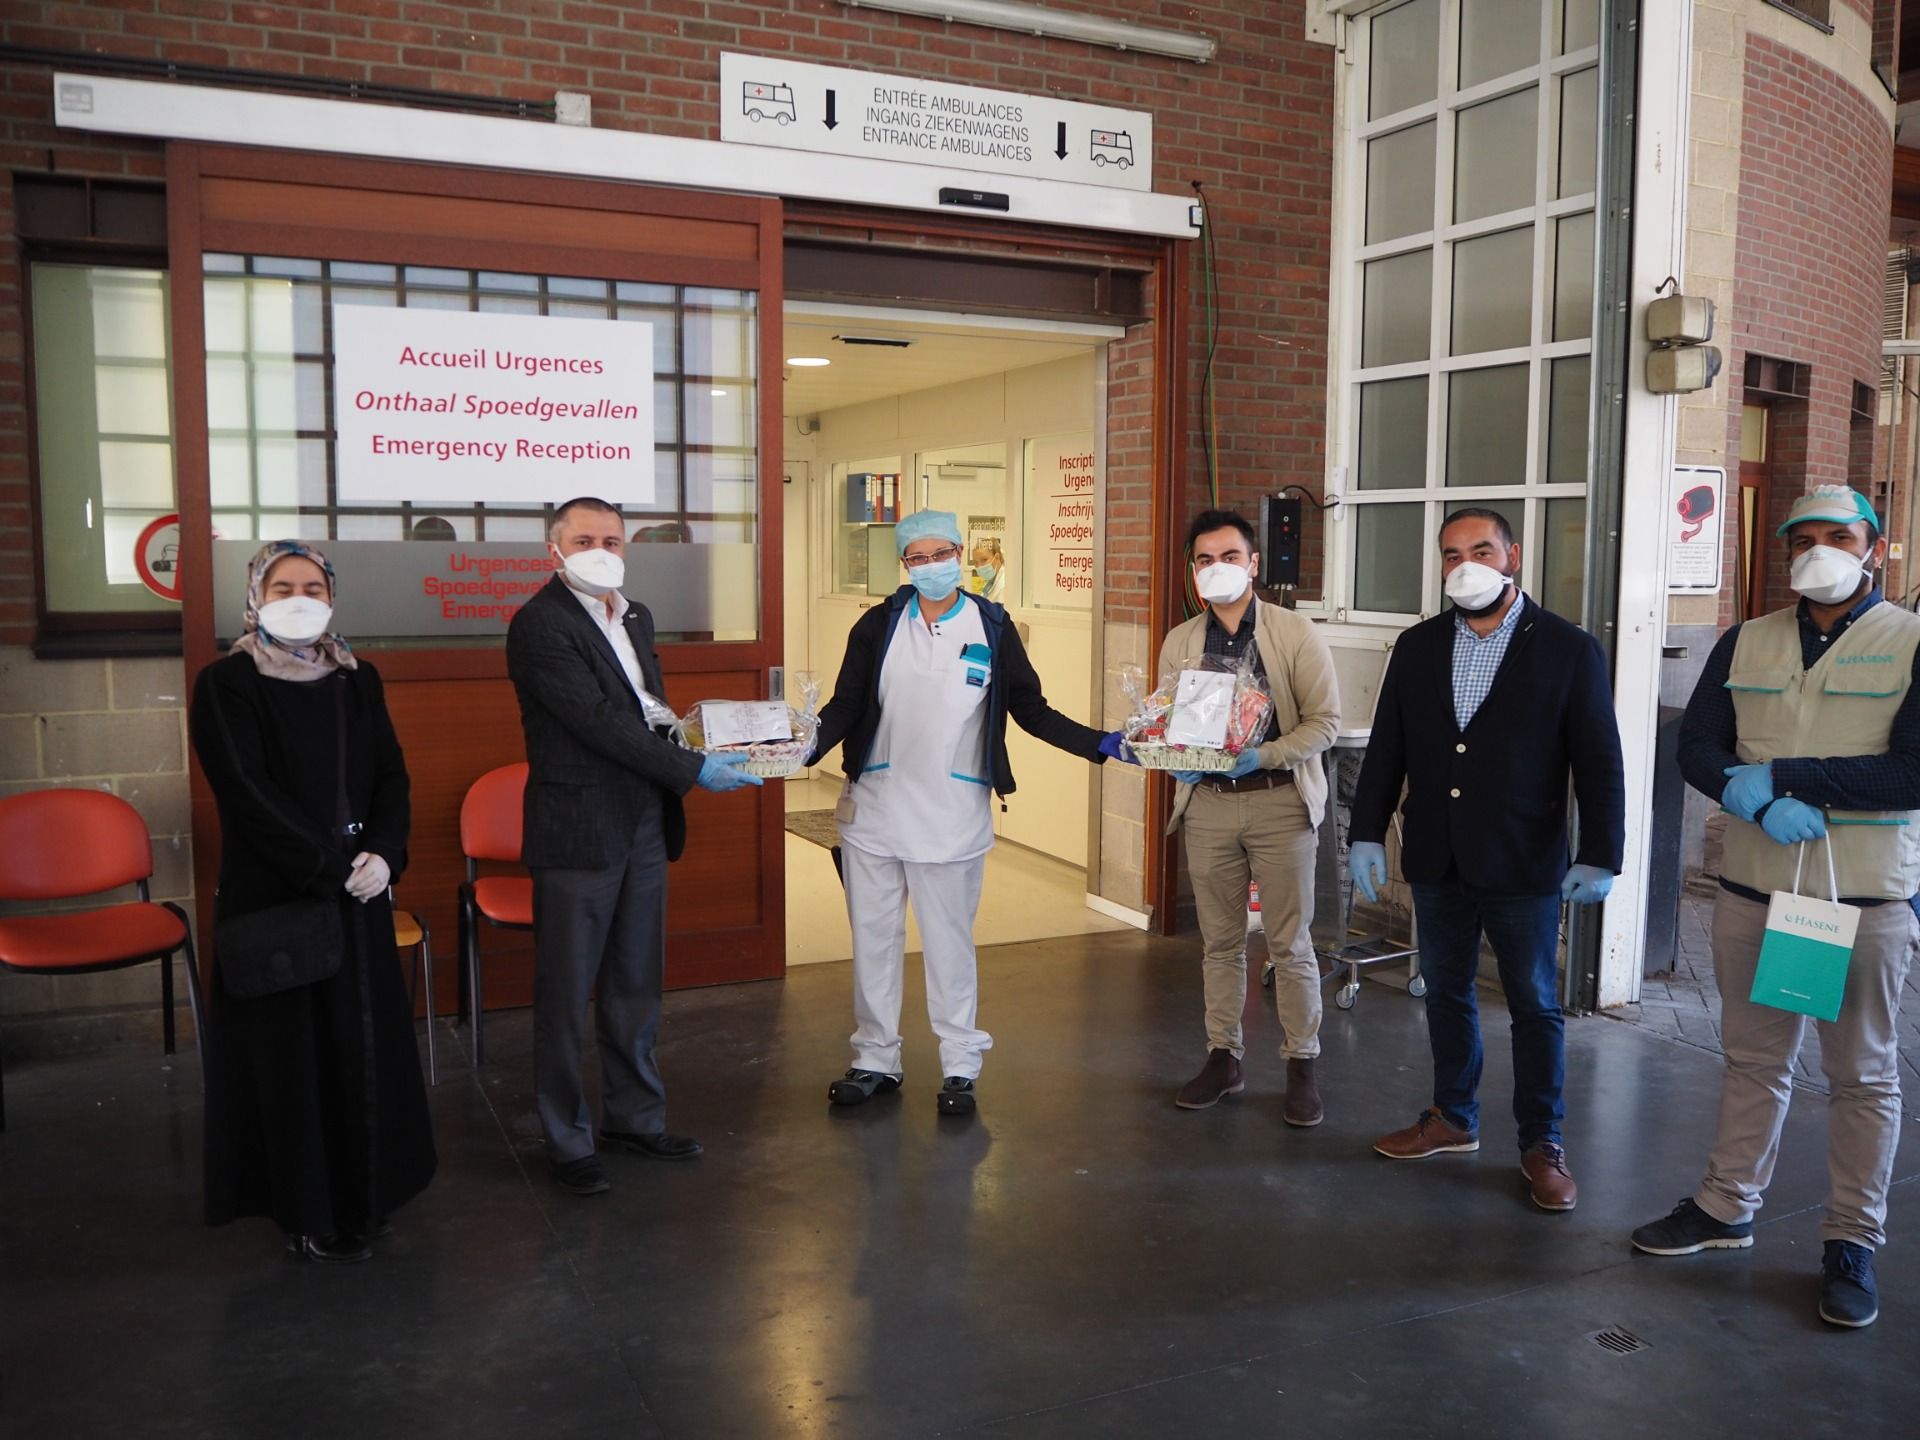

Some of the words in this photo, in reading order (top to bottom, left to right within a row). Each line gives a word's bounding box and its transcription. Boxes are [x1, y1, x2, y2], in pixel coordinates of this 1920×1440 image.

[874, 87, 928, 108] ENTRÉE
[931, 96, 1023, 122] AMBULANCES
[866, 107, 921, 128] INGANG
[924, 115, 1029, 142] ZIEKENWAGENS
[863, 126, 937, 150] ENTRANCE
[940, 137, 1033, 162] AMBULANCES
[399, 346, 486, 369] Accueil
[495, 351, 604, 376] Urgences
[355, 391, 457, 413] Onthaal
[464, 395, 639, 421] Spoedgevallen
[372, 434, 508, 461] Emergency
[516, 438, 631, 463] Reception
[449, 553, 553, 577] Urgences
[1059, 553, 1093, 572] Emerge
[1056, 573, 1093, 592] Registra
[442, 600, 520, 623] Emerg
[1795, 914, 1840, 934] HASENE
